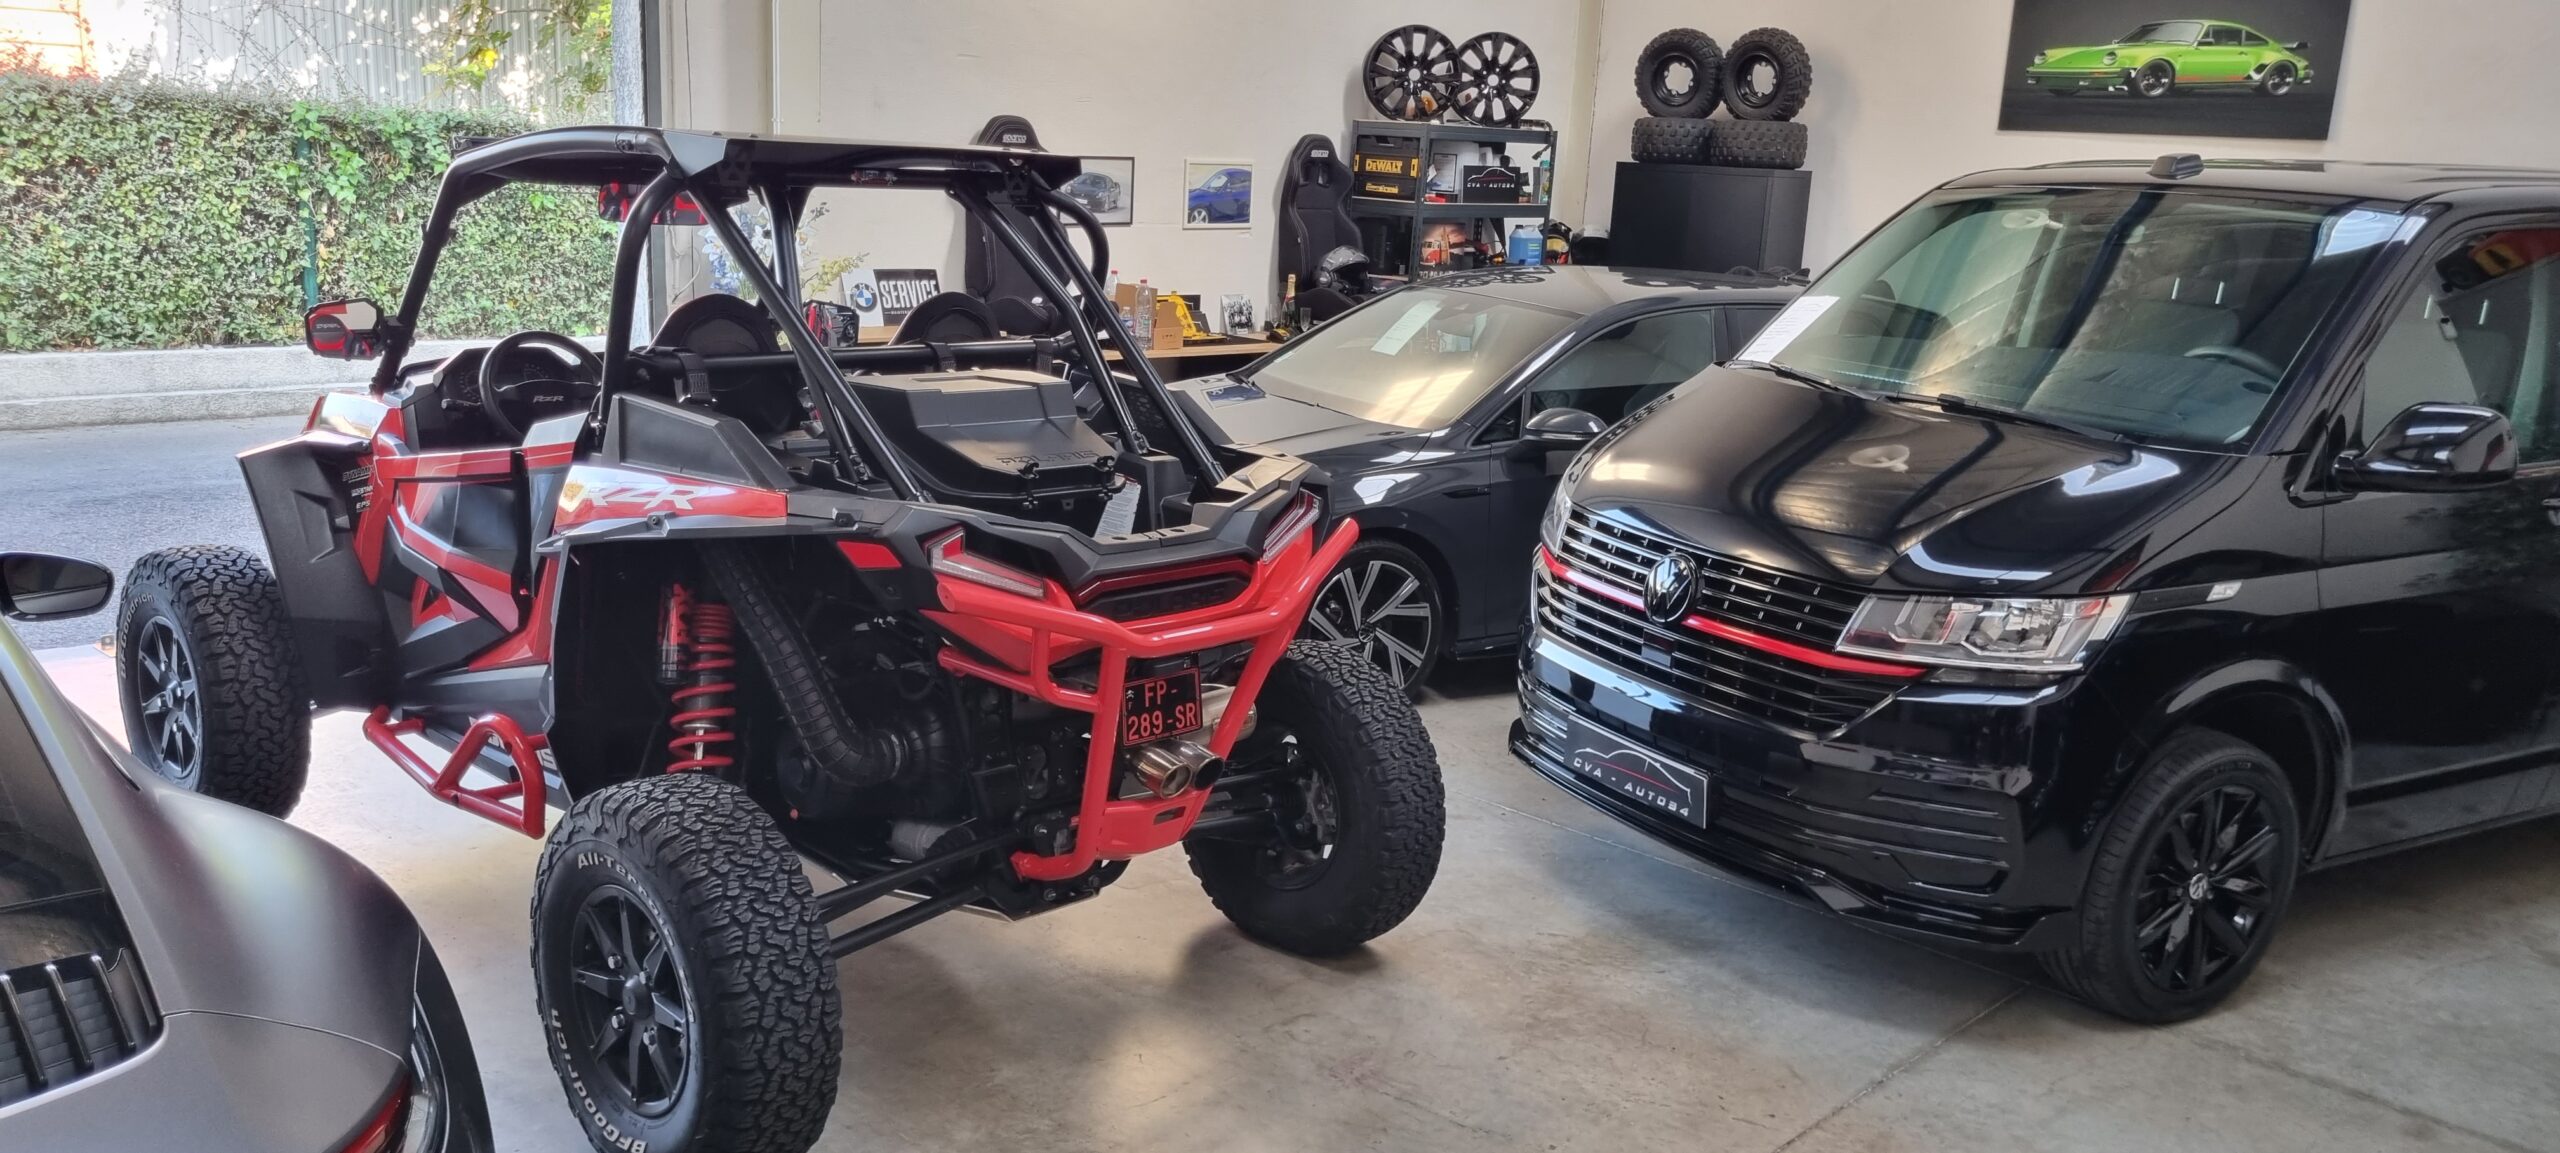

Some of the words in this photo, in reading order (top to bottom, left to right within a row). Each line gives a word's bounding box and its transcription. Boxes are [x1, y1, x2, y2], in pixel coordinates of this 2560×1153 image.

[533, 395, 564, 403] RZR
[567, 482, 709, 511] RZR
[1128, 702, 1196, 740] 289-SR
[1573, 757, 1602, 778] CVA
[551, 1008, 647, 1153] BFGoodrich
